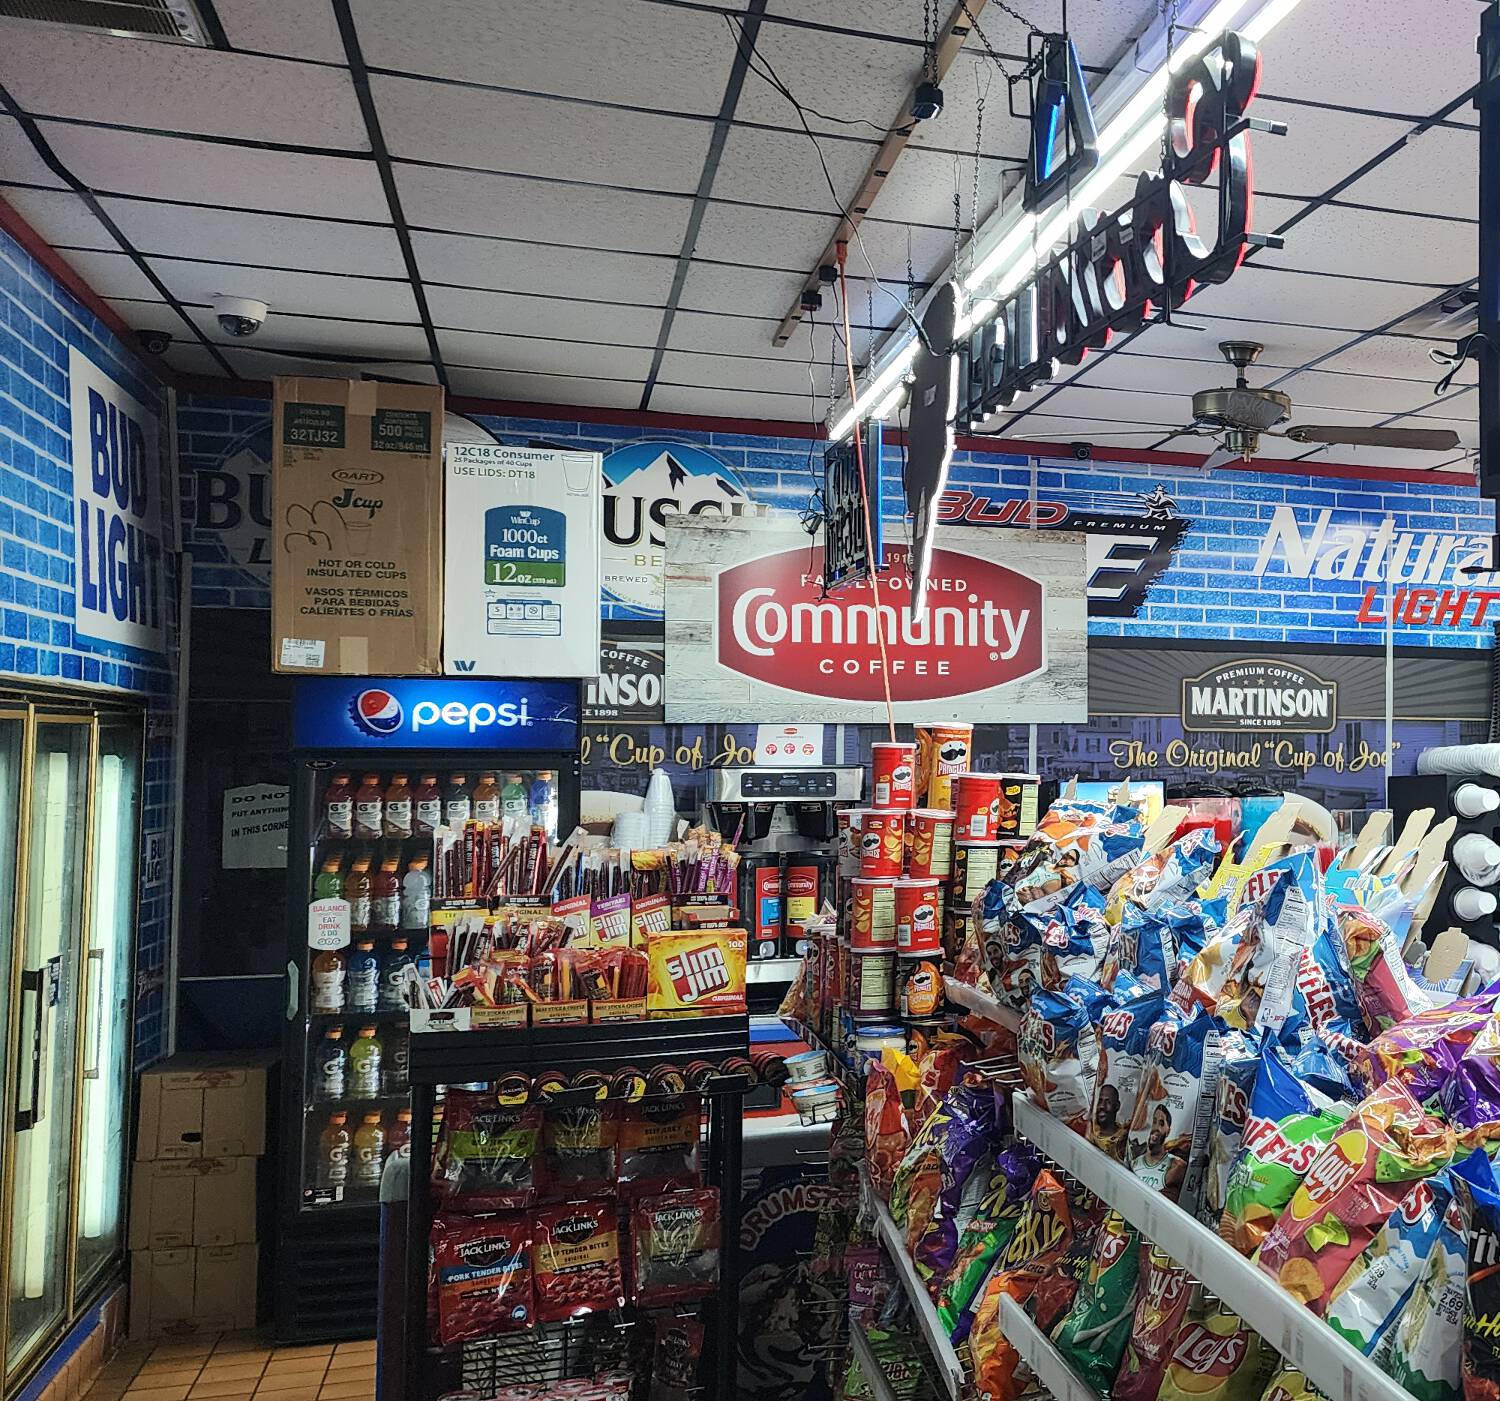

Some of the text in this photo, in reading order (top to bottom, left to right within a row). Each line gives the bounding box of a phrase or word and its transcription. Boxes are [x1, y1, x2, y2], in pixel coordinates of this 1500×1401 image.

[290, 428, 339, 443] 32TJ32
[378, 424, 402, 437] 500
[88, 386, 149, 519] BUD
[453, 446, 555, 461] 12C18 Consumer
[463, 458, 495, 467] Packages
[338, 471, 378, 482] DART
[453, 467, 536, 479] USE LIDS: DT18
[936, 490, 1071, 527] BUD
[510, 515, 541, 527] WinCup
[1073, 520, 1167, 532] PREMIUM
[489, 544, 560, 561] Foam Cups
[79, 498, 160, 630] LIGHT
[318, 558, 396, 570] HOT OR COLD
[307, 568, 407, 580] INSULATED CUPS
[604, 575, 649, 583] BREWED
[305, 586, 344, 596] VASOS
[314, 598, 345, 607] PARA
[300, 607, 364, 616] CALIENTES
[732, 588, 1031, 660] Community
[600, 649, 650, 669] COFFEE
[819, 659, 950, 675] COFFEE
[1215, 667, 1306, 685] PREMIUM COFFEE
[1191, 686, 1330, 718] MARTINSON
[412, 697, 530, 733] pepsi
[594, 709, 619, 717] 1898
[675, 736, 704, 771] of
[1109, 739, 1345, 774] The Original of
[938, 761, 967, 775] PRINGLES
[231, 794, 256, 803] DO
[231, 810, 249, 818] PUT
[231, 825, 261, 838] IN THIS
[312, 904, 347, 913] BALANCE
[553, 899, 588, 913] ORIGINAL
[596, 896, 626, 910] TERIYAKI
[635, 895, 668, 910] ORIGINAL
[594, 912, 625, 932] slim
[728, 940, 744, 949] 100
[666, 946, 724, 980] slim
[681, 963, 730, 1003] Jim
[711, 994, 744, 1003] ORIGINAL
[654, 1210, 676, 1222] JACK
[552, 1224, 573, 1236] JACK
[460, 1246, 483, 1258] JACK
[560, 1241, 610, 1256] TENDER BITES
[449, 1272, 470, 1282] PORK
[471, 1267, 501, 1278] TENDER
[1439, 1293, 1464, 1312] 2.69
